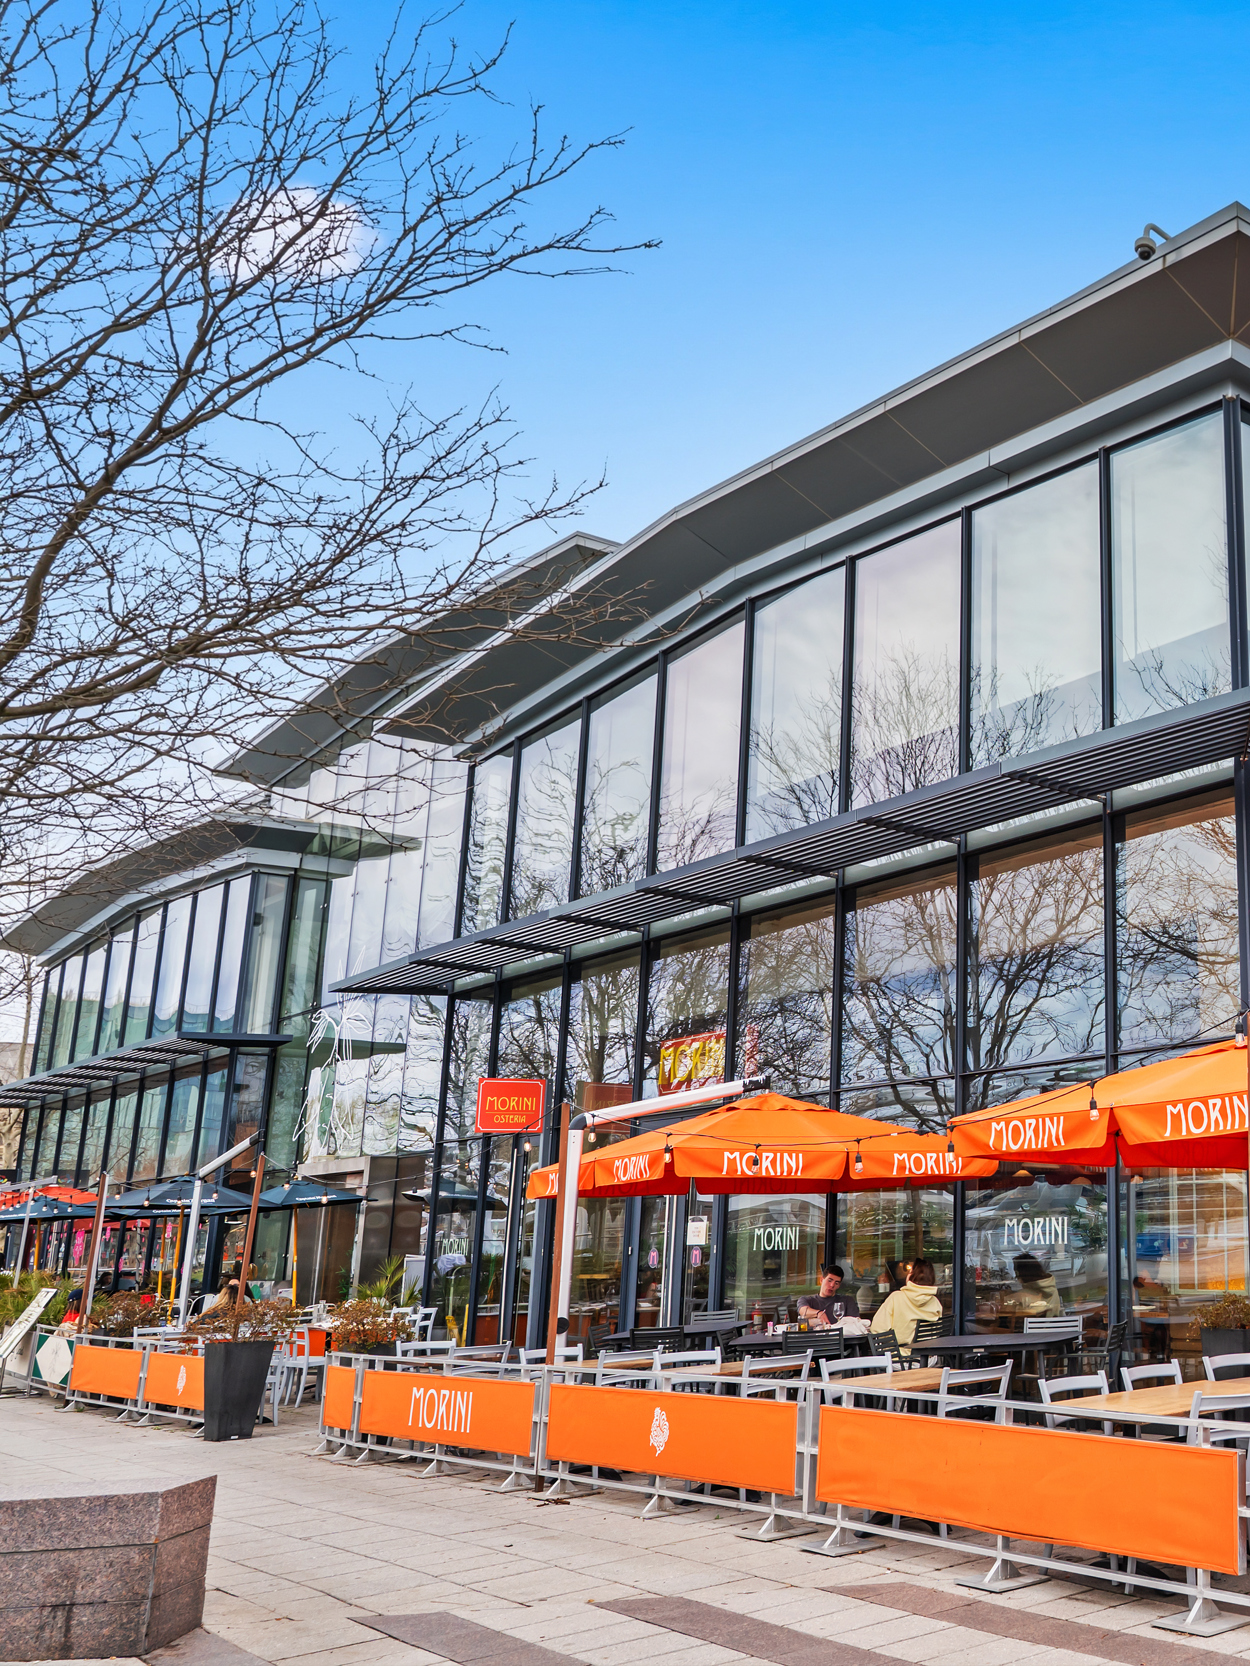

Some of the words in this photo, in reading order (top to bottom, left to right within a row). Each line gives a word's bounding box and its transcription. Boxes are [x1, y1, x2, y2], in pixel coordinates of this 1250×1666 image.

[486, 1096, 536, 1111] MORINI
[1164, 1094, 1248, 1137] MORIN
[493, 1115, 526, 1123] OSTERIA
[989, 1115, 1065, 1151] MORINI
[614, 1154, 650, 1182] MORINI
[722, 1151, 803, 1176] MORINI
[892, 1153, 962, 1175] MORINI
[753, 1226, 800, 1251] MORINI
[1003, 1216, 1068, 1246] MORINI
[441, 1238, 469, 1256] MORINI
[408, 1386, 473, 1434] MORINI
